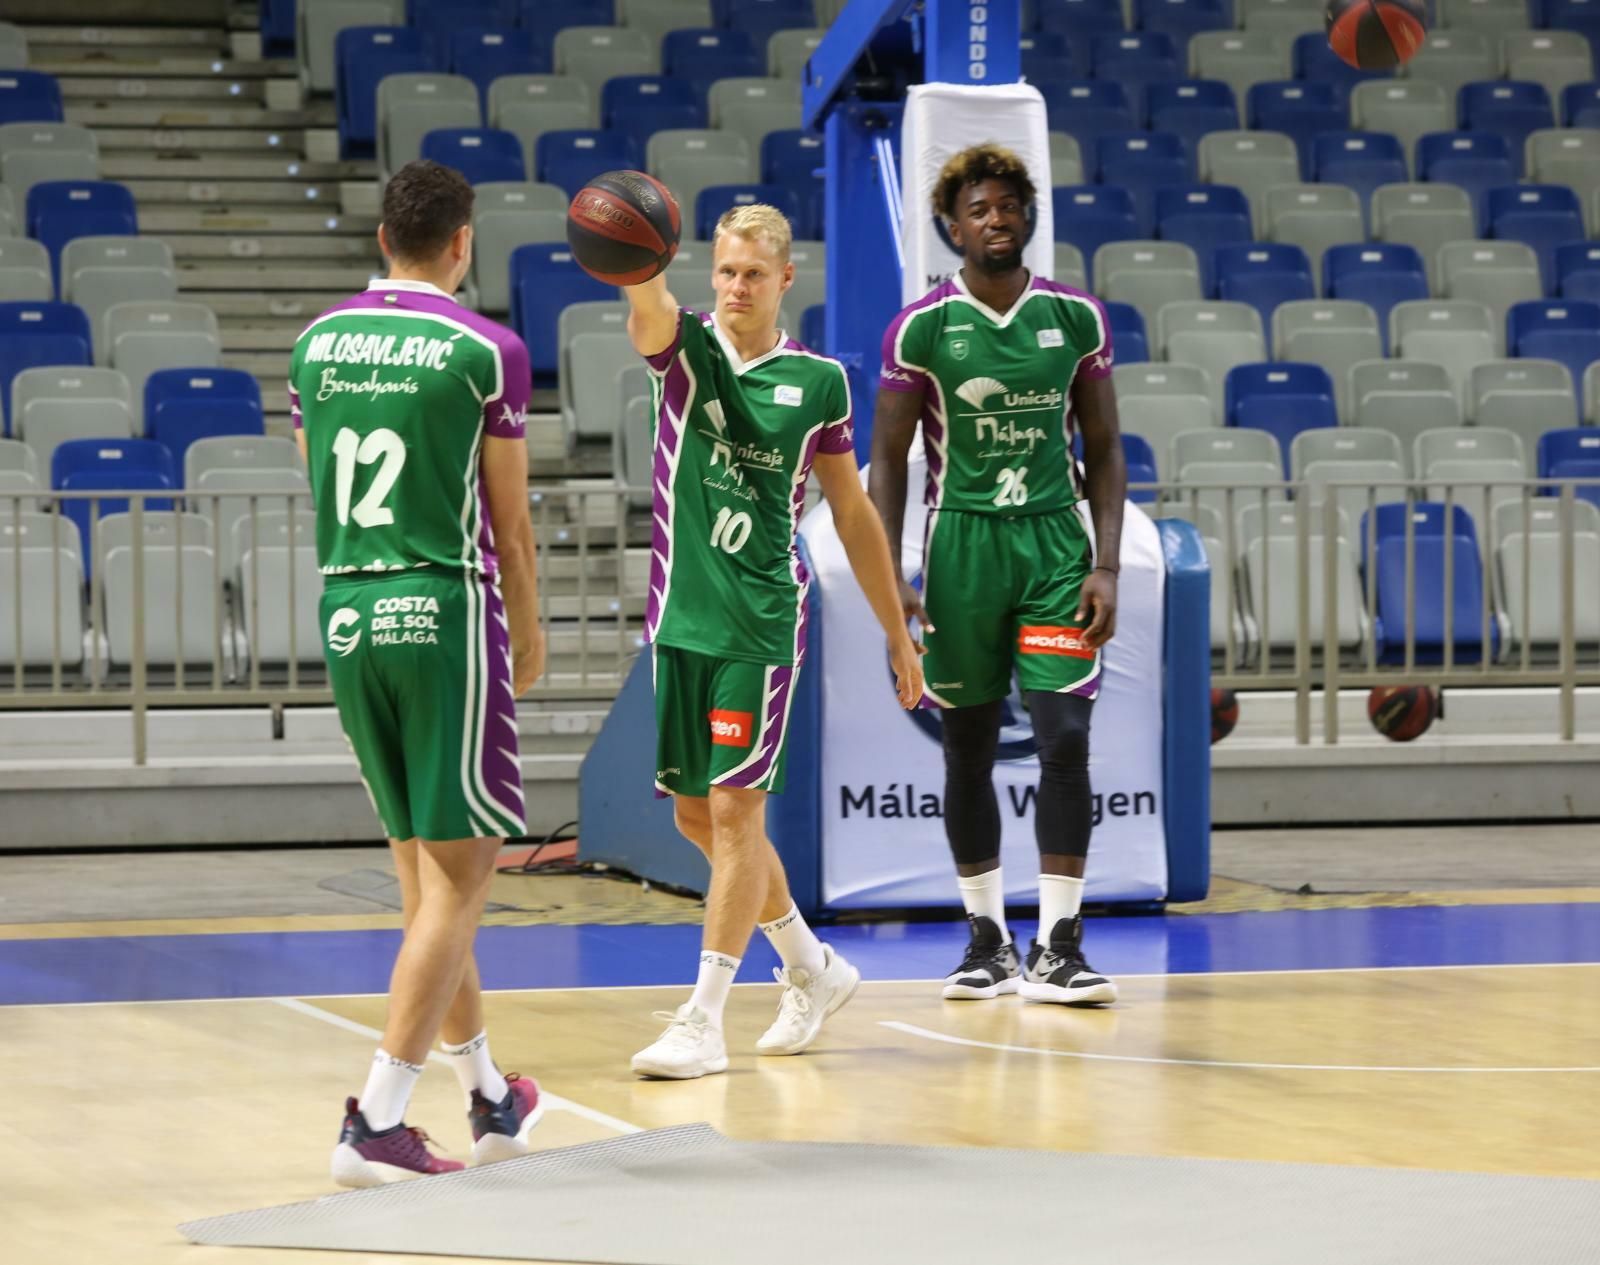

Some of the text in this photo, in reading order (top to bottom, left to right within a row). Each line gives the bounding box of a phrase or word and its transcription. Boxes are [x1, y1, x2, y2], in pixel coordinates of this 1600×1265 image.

[969, 0, 988, 80] ONDO
[304, 332, 464, 371] MILOSAVLJEVIĆ
[1004, 388, 1062, 407] Unicaja
[732, 441, 784, 468] nicaja
[332, 427, 406, 528] 12
[993, 467, 1028, 507] 26
[709, 506, 752, 554] 10
[374, 596, 440, 614] COSTA
[371, 615, 439, 631] DEL SOL
[372, 630, 438, 646] MÁLAGA
[840, 784, 945, 819] Mála
